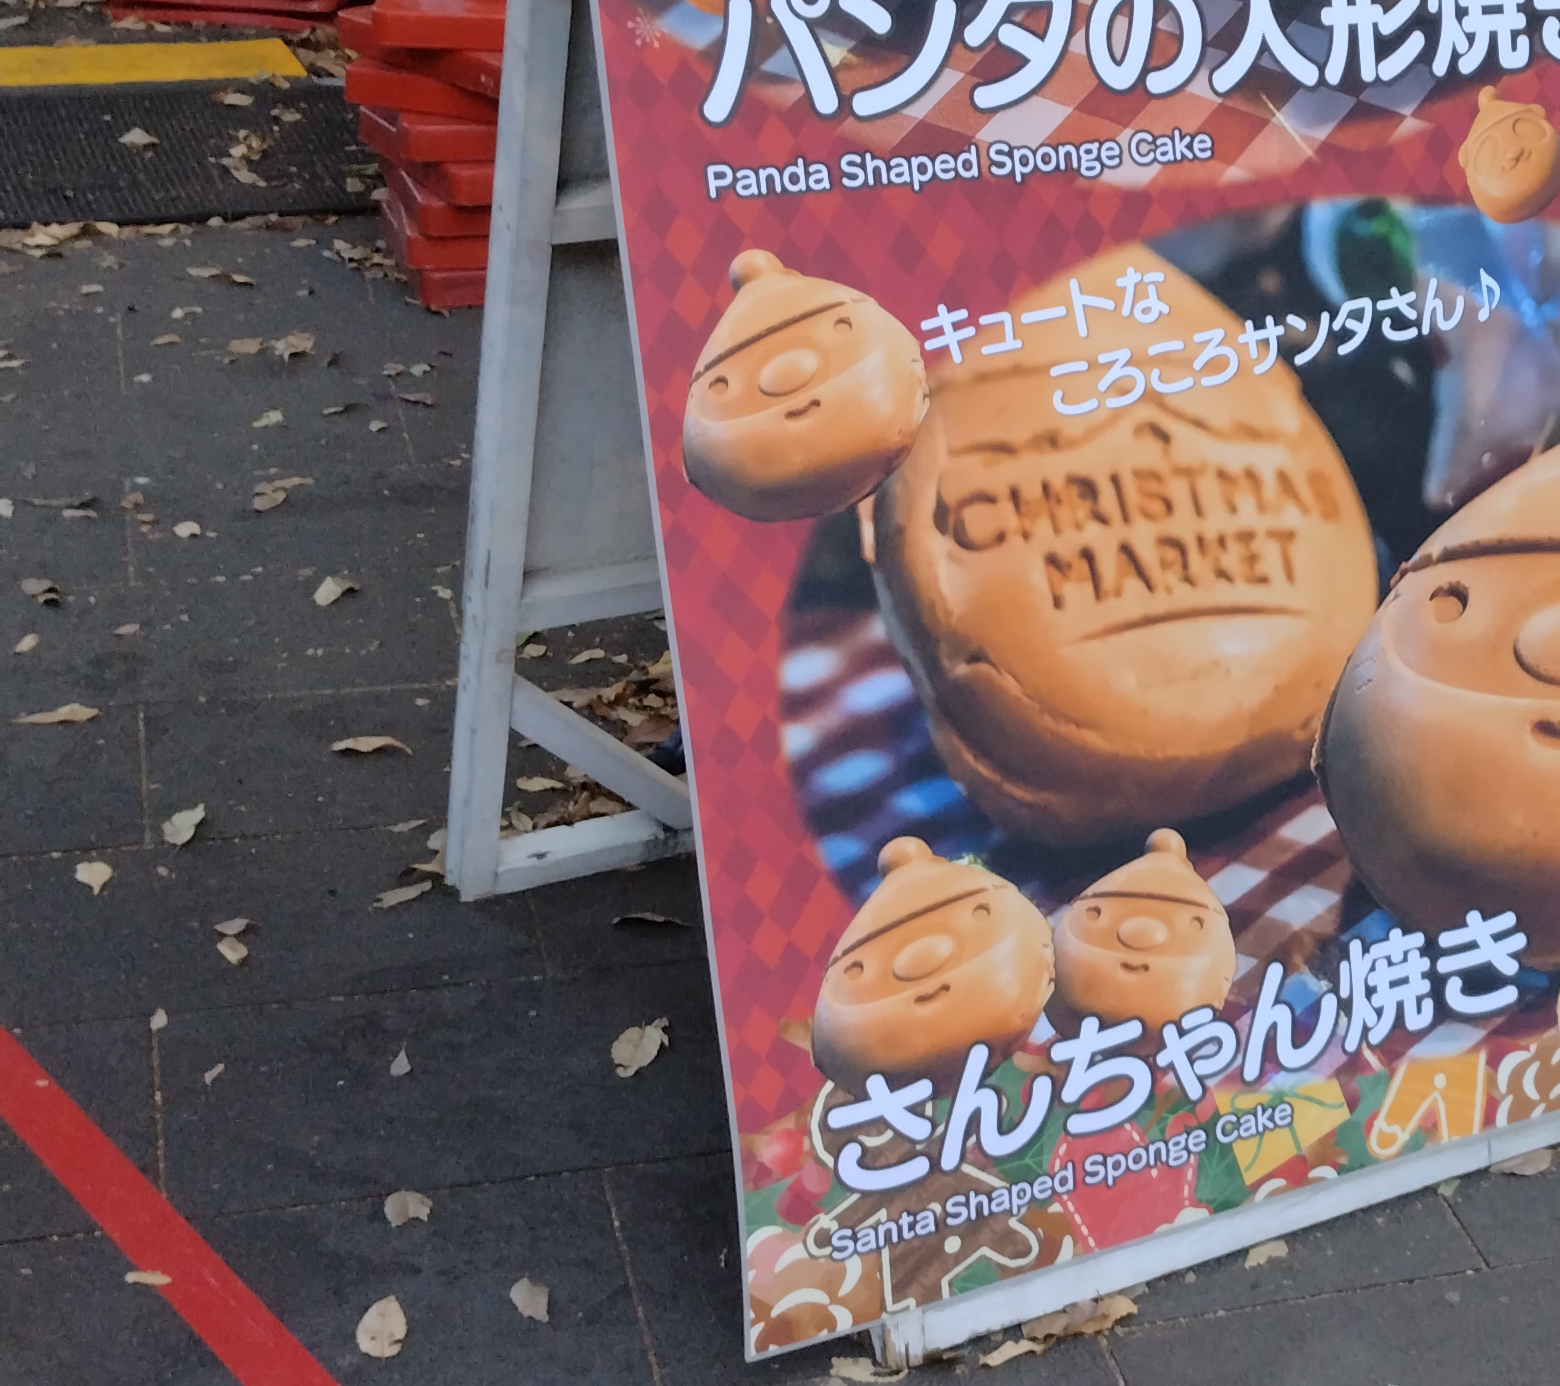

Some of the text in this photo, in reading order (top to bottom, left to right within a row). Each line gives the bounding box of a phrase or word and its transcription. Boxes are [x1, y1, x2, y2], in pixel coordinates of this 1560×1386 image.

[706, 128, 1213, 199] Panda Shaped Sponge Cake
[920, 266, 1171, 364] キュートな
[948, 463, 1341, 553] CHRISTMAS
[1044, 528, 1298, 612] MARKET
[824, 909, 1530, 1194] さんちゃん焼き
[831, 1101, 1293, 1260] Santa Shaped Sponge Cake
